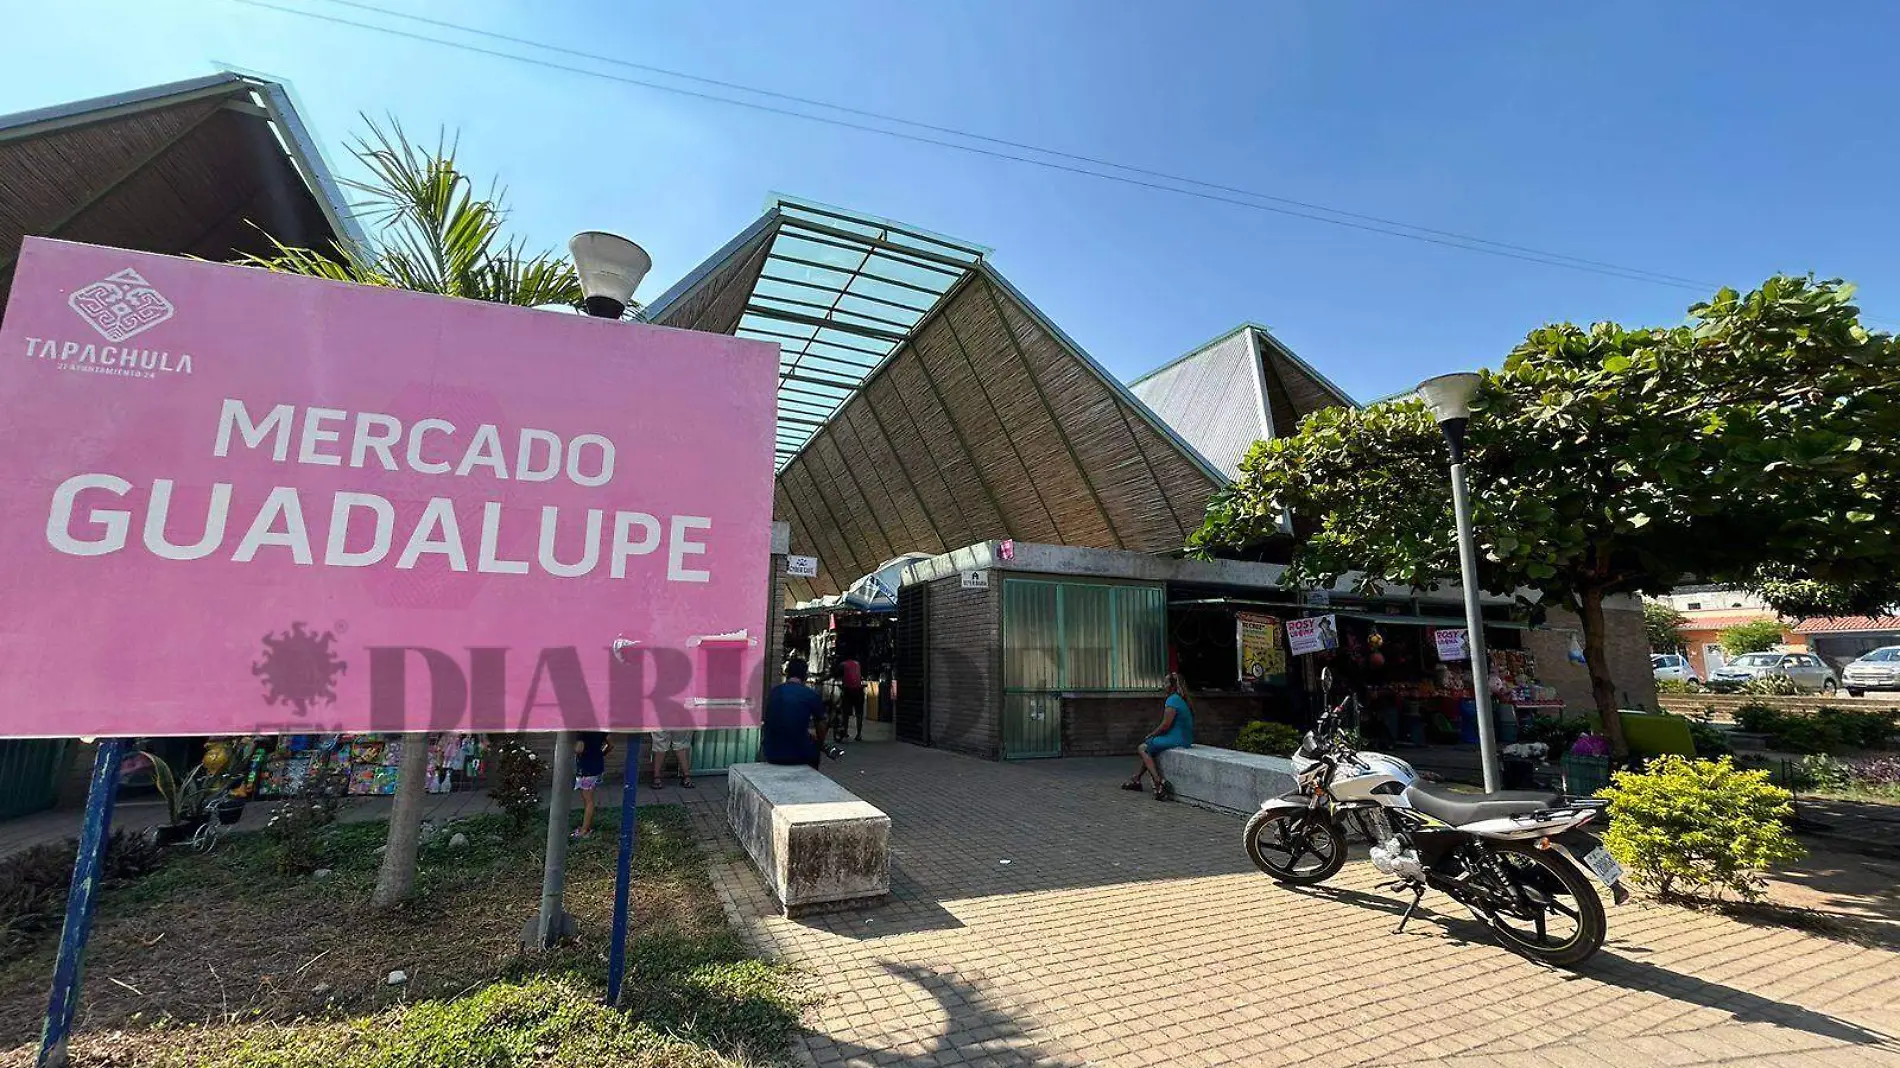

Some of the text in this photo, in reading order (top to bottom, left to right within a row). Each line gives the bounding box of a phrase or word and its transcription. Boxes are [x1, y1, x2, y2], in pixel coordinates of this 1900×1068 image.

[25, 336, 192, 374] TAPACHULA
[213, 398, 616, 488] MERCADO
[45, 472, 712, 582] GUADALUPE
[1289, 619, 1315, 631] ROSY
